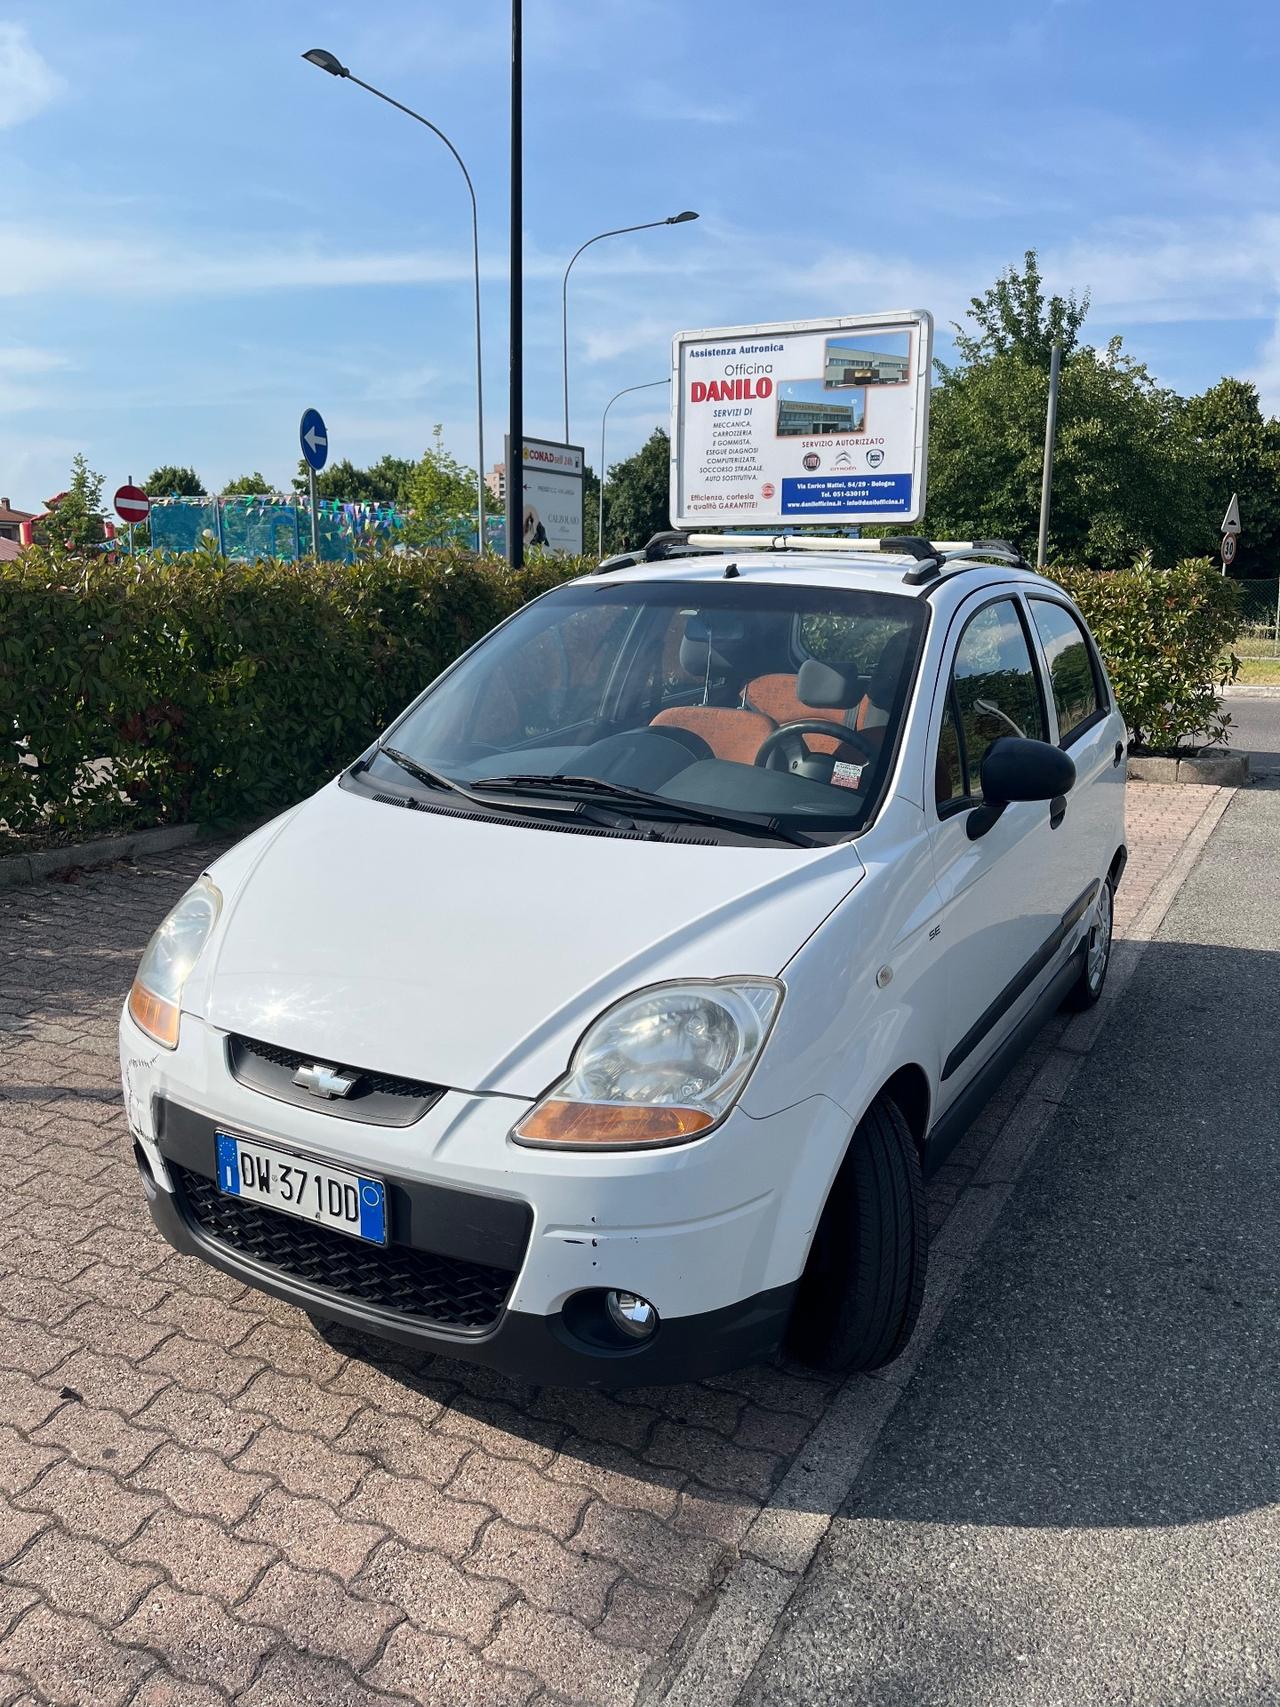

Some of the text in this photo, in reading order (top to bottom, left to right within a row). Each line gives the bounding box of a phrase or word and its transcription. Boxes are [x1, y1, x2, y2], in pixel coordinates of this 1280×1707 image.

[690, 344, 784, 358] Assistenza Autronica
[724, 363, 773, 376] Officina
[691, 376, 773, 403] DANILO
[713, 408, 753, 417] SERVIZI DI
[802, 438, 885, 448] SERVIZIO AUTORIZZATO
[530, 450, 554, 463] CONAD
[1224, 541, 1234, 556] 30
[929, 924, 941, 941] SE
[240, 1152, 271, 1194] DW
[278, 1163, 359, 1223] 371DD
